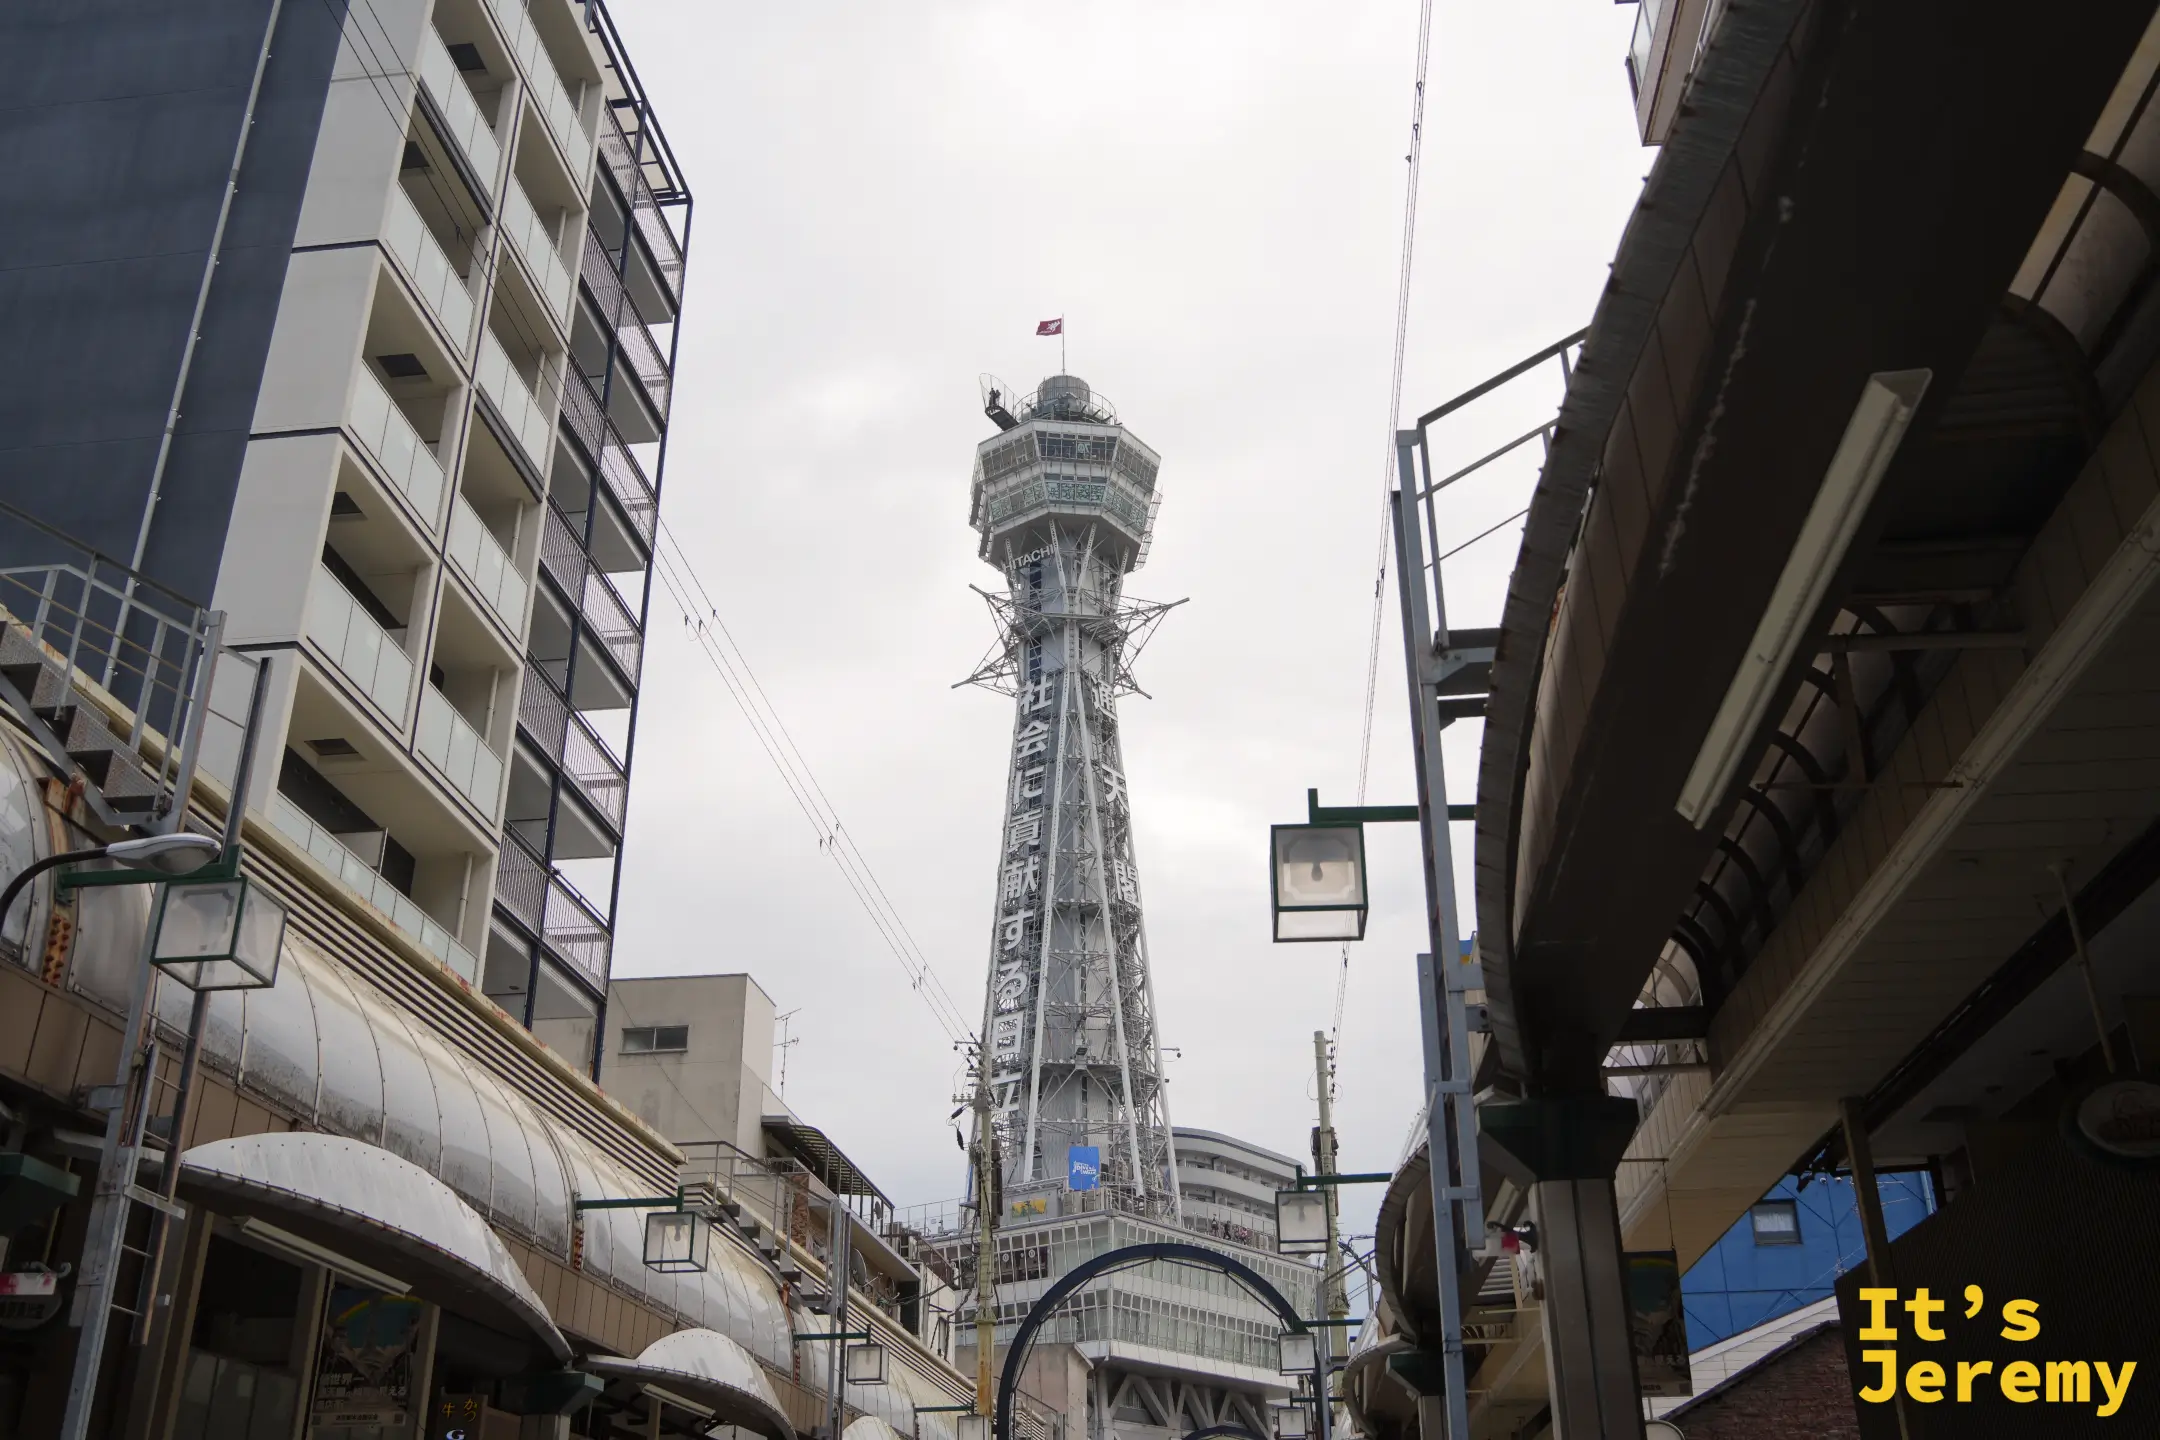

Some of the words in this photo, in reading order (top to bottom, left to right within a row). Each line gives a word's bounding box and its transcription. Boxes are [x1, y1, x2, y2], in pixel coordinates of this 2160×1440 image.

[1002, 543, 1055, 572] HITACHI
[1091, 676, 1142, 909] 通天閣
